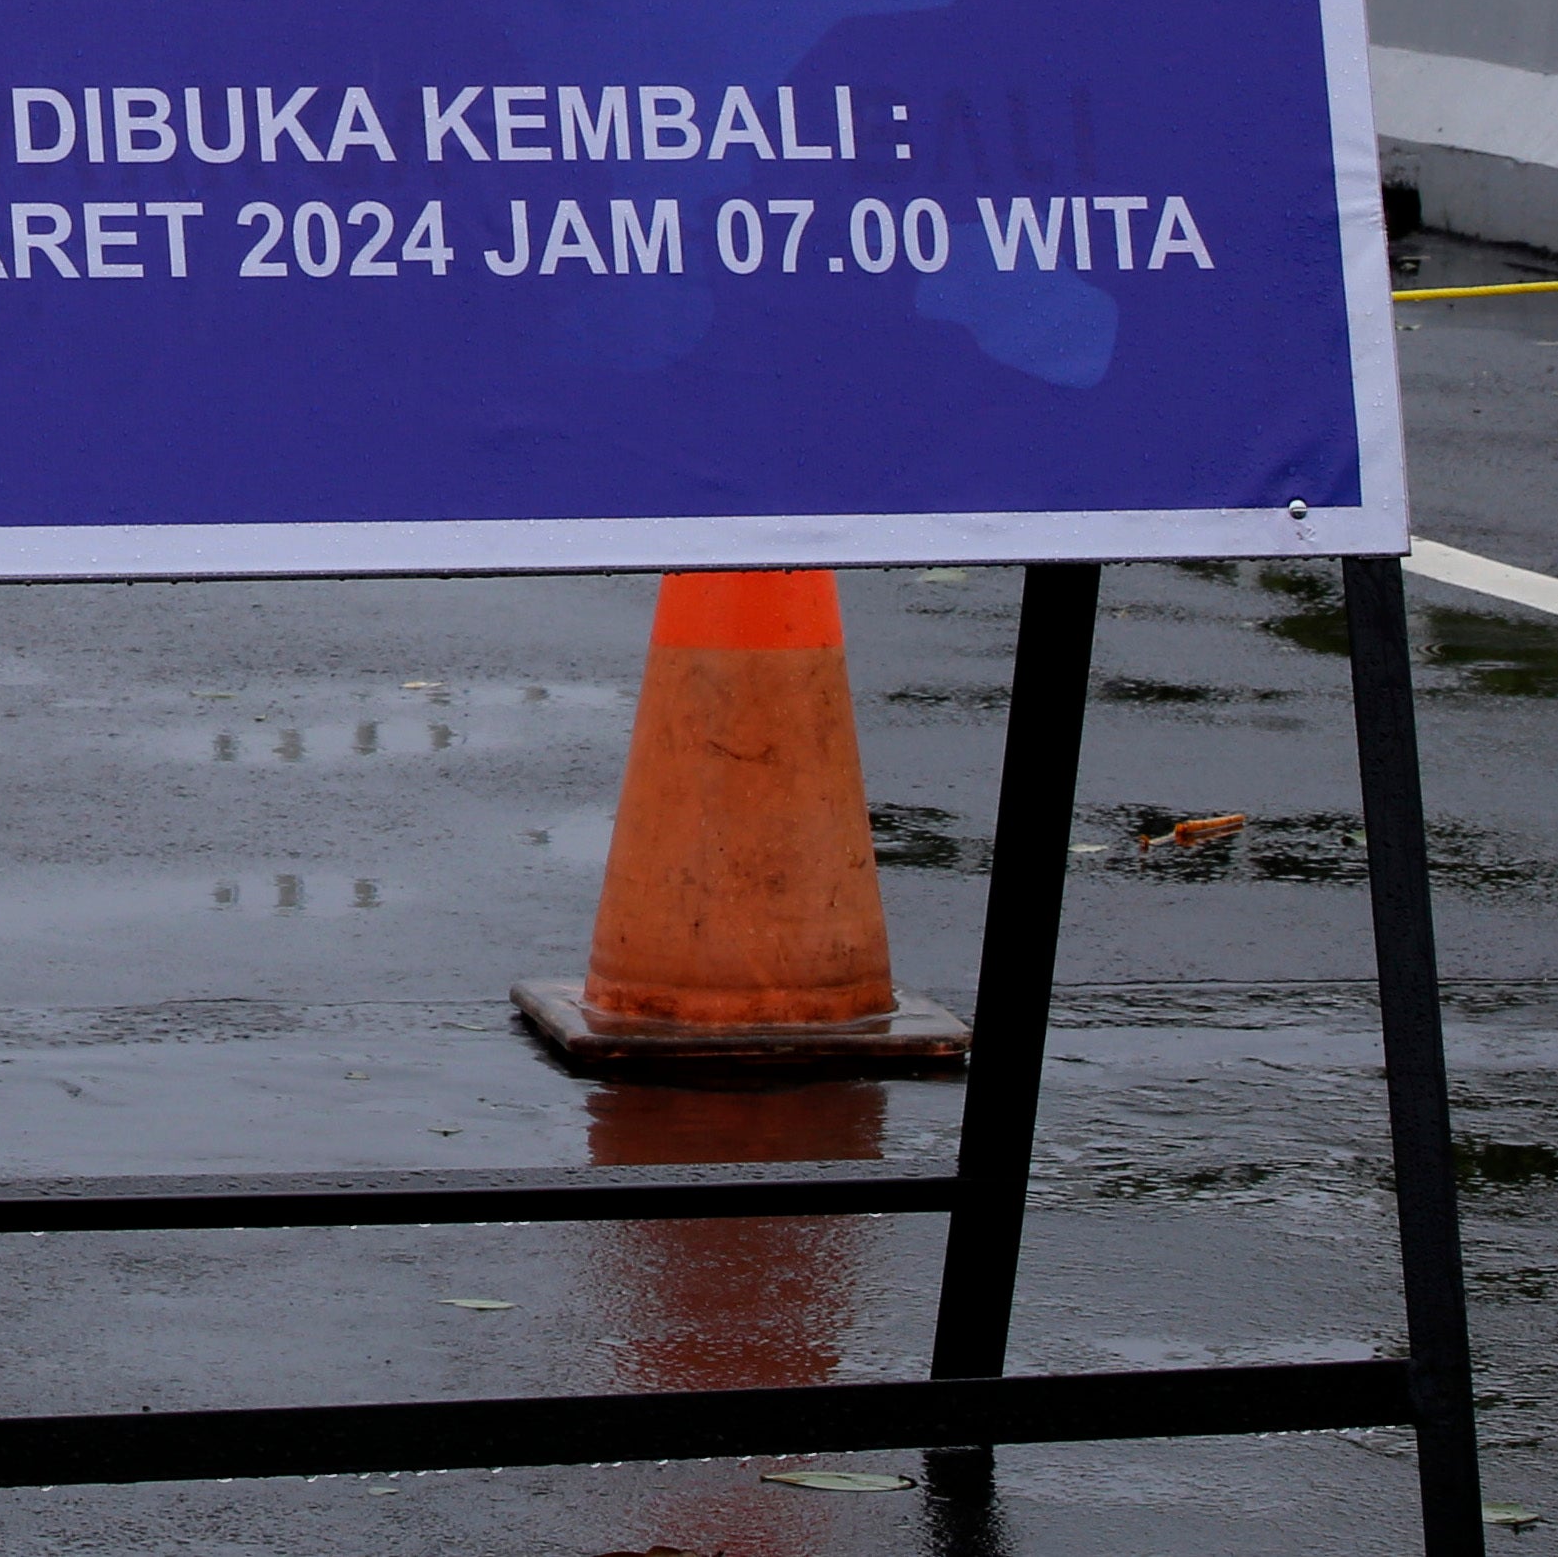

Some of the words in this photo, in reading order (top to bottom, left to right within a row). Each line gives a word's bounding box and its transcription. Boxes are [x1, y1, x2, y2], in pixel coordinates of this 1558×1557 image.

[13, 88, 397, 163] DIBUKA
[423, 86, 856, 161] KEMBALI
[238, 201, 454, 278] 2024
[484, 200, 683, 276] JAM
[718, 199, 949, 274] 07.00
[978, 197, 1215, 272] WITA
